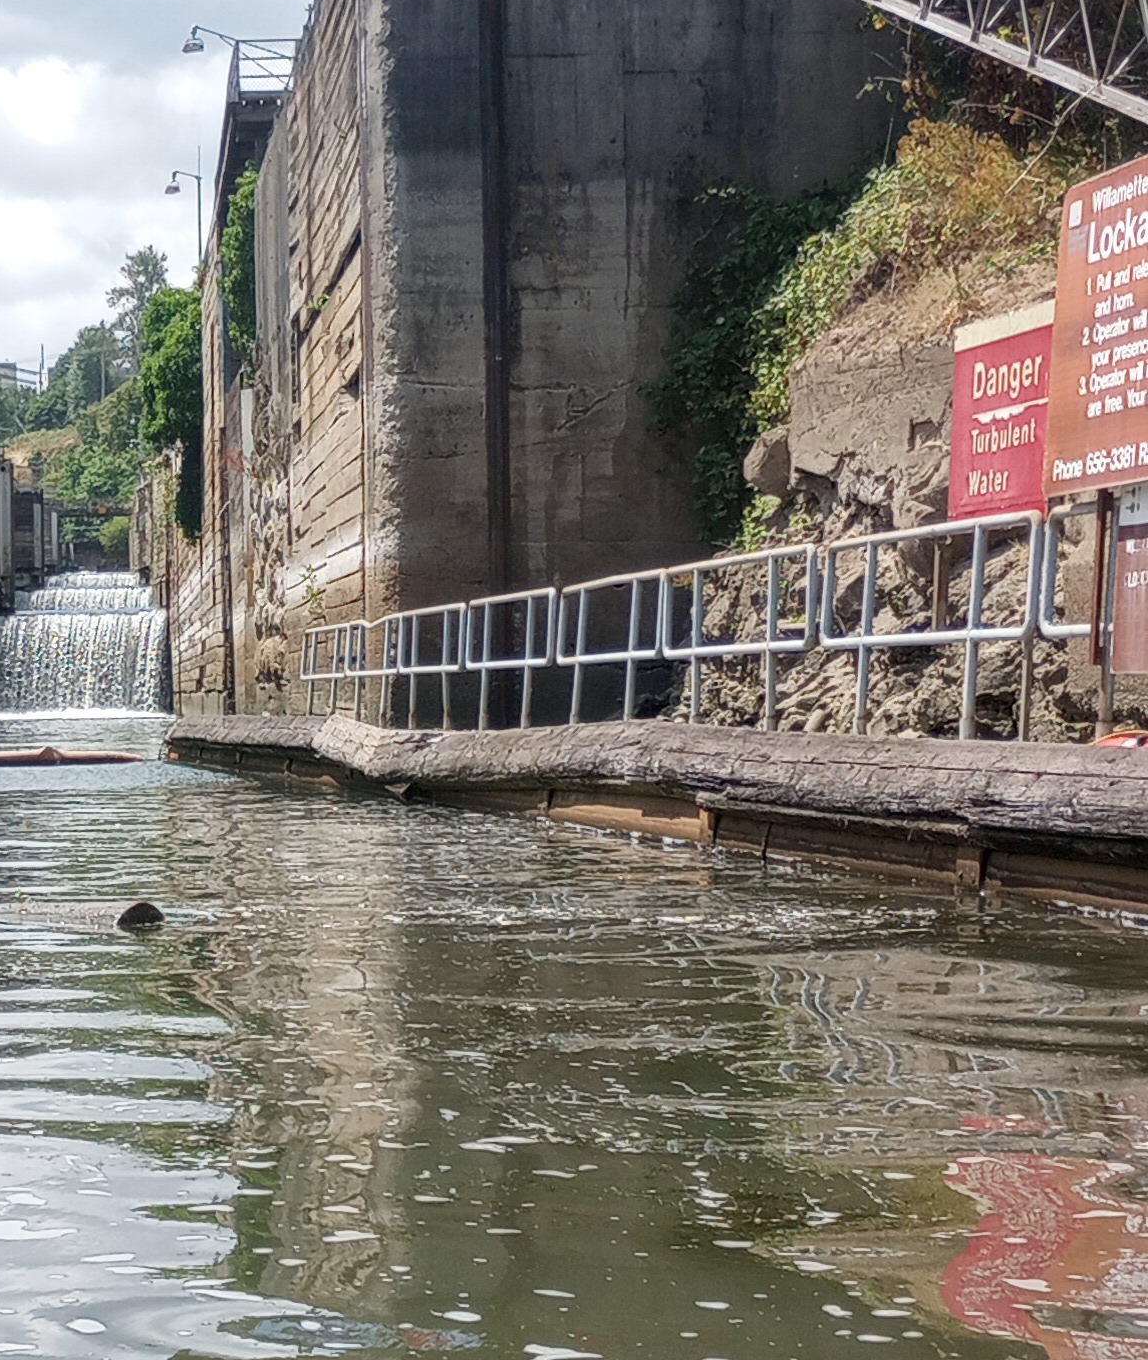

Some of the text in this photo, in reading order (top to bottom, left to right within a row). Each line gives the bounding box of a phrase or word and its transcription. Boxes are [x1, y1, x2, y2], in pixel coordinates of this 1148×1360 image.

[1113, 263, 1131, 288] and
[1094, 294, 1112, 319] and
[1092, 316, 1131, 346] Operator
[1132, 307, 1148, 332] will
[972, 354, 1043, 400] Danger
[1091, 348, 1111, 373] your
[1089, 367, 1127, 396] Operator
[1129, 360, 1145, 382] will
[1086, 400, 1103, 419] are
[1126, 387, 1148, 409] Your
[971, 417, 1036, 455] Turbulent
[1052, 458, 1083, 482] Phone
[1085, 443, 1137, 476] 656-3381
[968, 468, 1009, 497] Water
